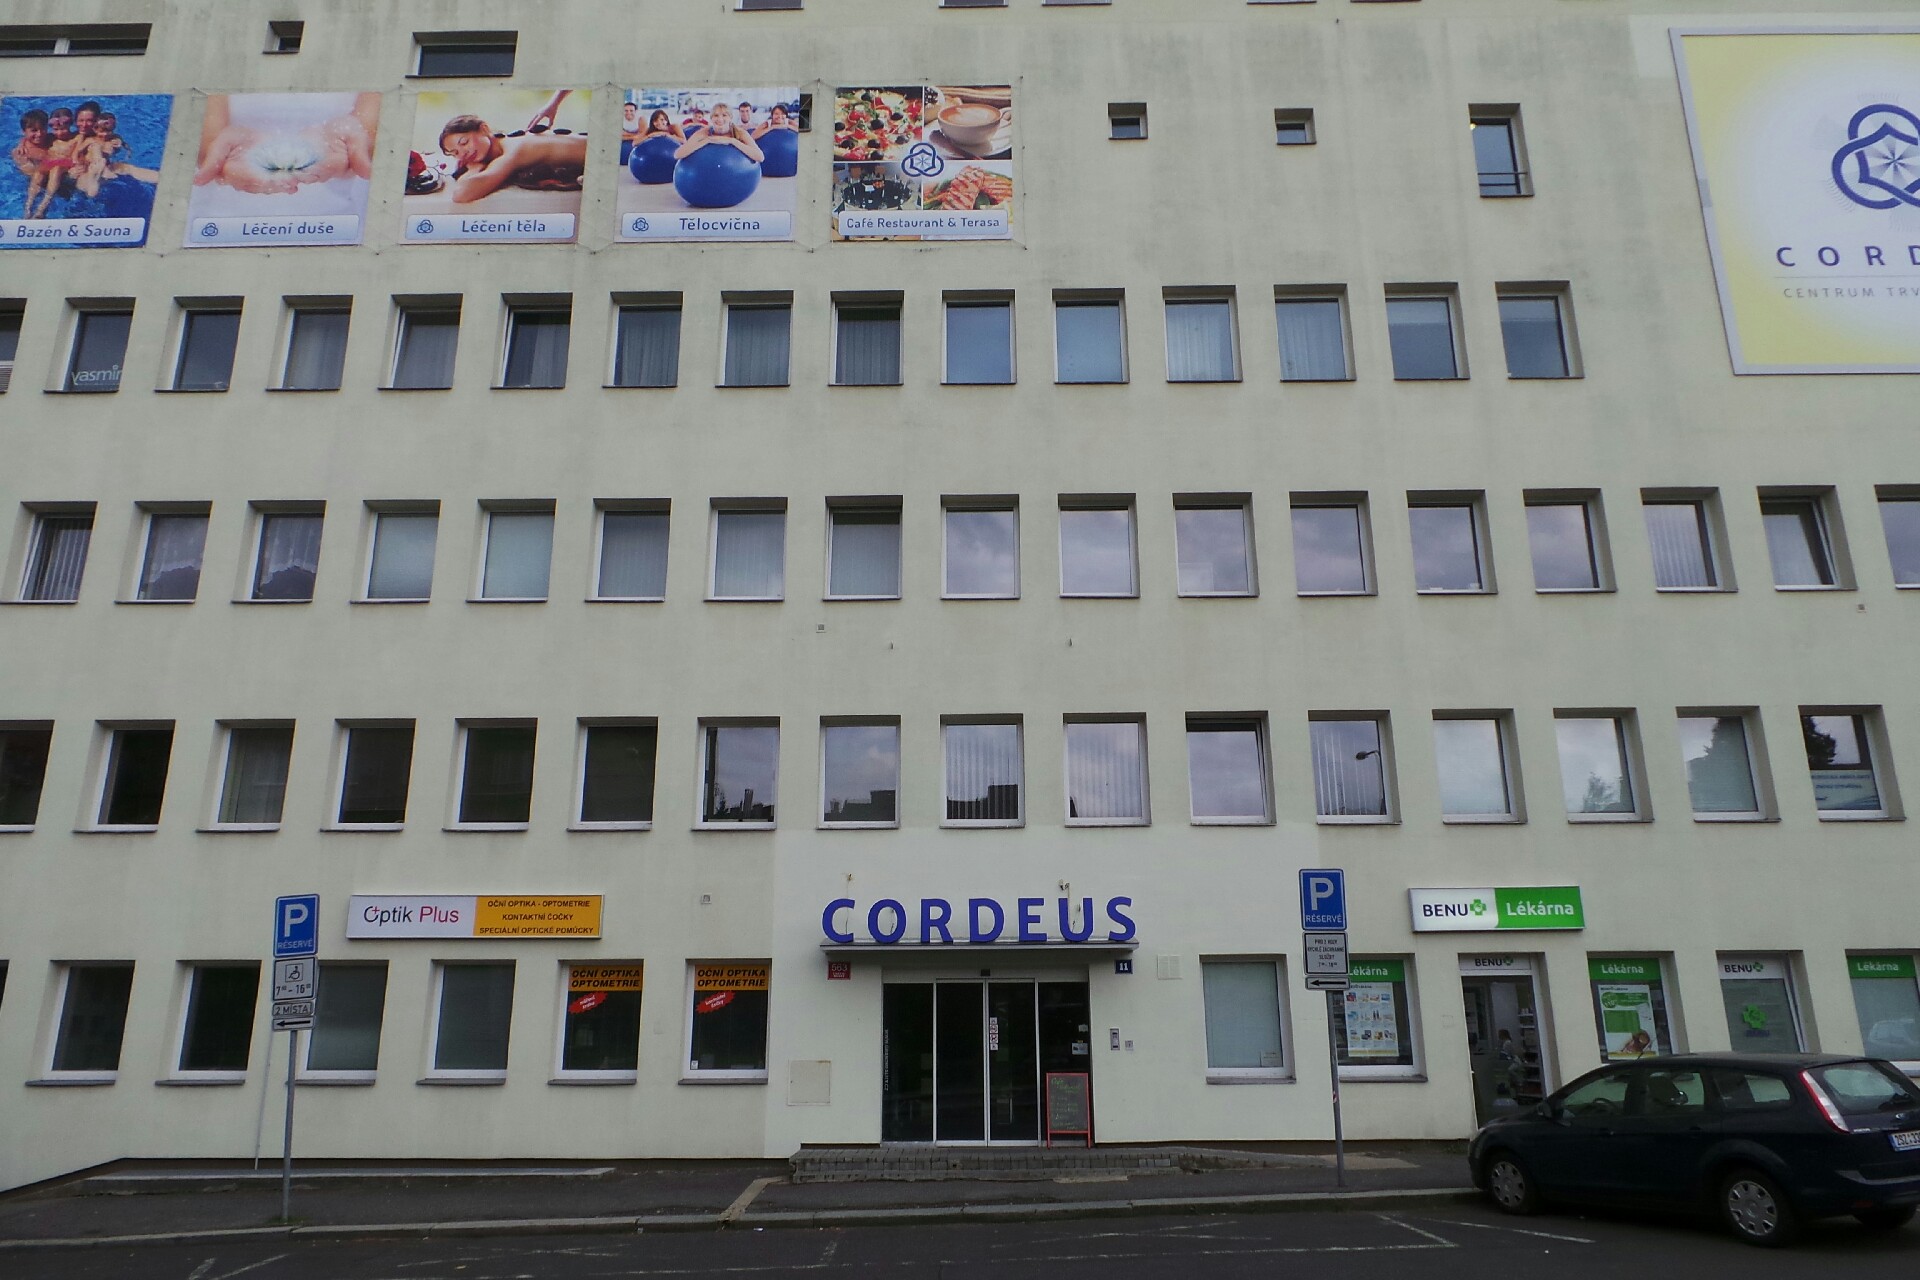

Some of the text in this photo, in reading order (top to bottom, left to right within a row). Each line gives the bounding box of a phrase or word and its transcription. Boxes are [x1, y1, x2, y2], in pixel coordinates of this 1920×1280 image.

[462, 219, 546, 233] Léčení těla
[679, 216, 760, 231] Tělocvična
[847, 216, 1000, 228] Café Restaurant & Terasa
[17, 223, 131, 238] Bazén & Sauna
[242, 221, 335, 236] Léčení duše
[1783, 287, 1875, 298] CENTRUM
[1309, 877, 1335, 911] P
[487, 899, 507, 908] OČNÍ
[542, 899, 591, 907] OPTOMETRIE
[1506, 900, 1575, 916] Lékárna
[1422, 903, 1469, 917] BENU
[284, 903, 309, 938] P
[363, 905, 460, 927] Optik Plus
[502, 912, 574, 920] KONTAKTNÍ ČOČKY
[821, 896, 1137, 944] CORDEUS
[479, 925, 519, 934] SPECIÁLNÍ
[521, 926, 554, 934] OPTICKÉ
[831, 963, 848, 971] 563
[1119, 962, 1129, 971] 11
[1475, 957, 1503, 967] BENU
[1857, 961, 1899, 971] Lékárna
[571, 968, 640, 978] OČNÍ OPTIKA
[697, 967, 766, 977] OČNÍ OPTIKA
[1601, 963, 1644, 974] Lékárna
[1724, 964, 1753, 973] BENU
[571, 979, 640, 988] OPTOMETRIE
[697, 979, 766, 987] OPTOMETRIE
[275, 1007, 281, 1015] 2
